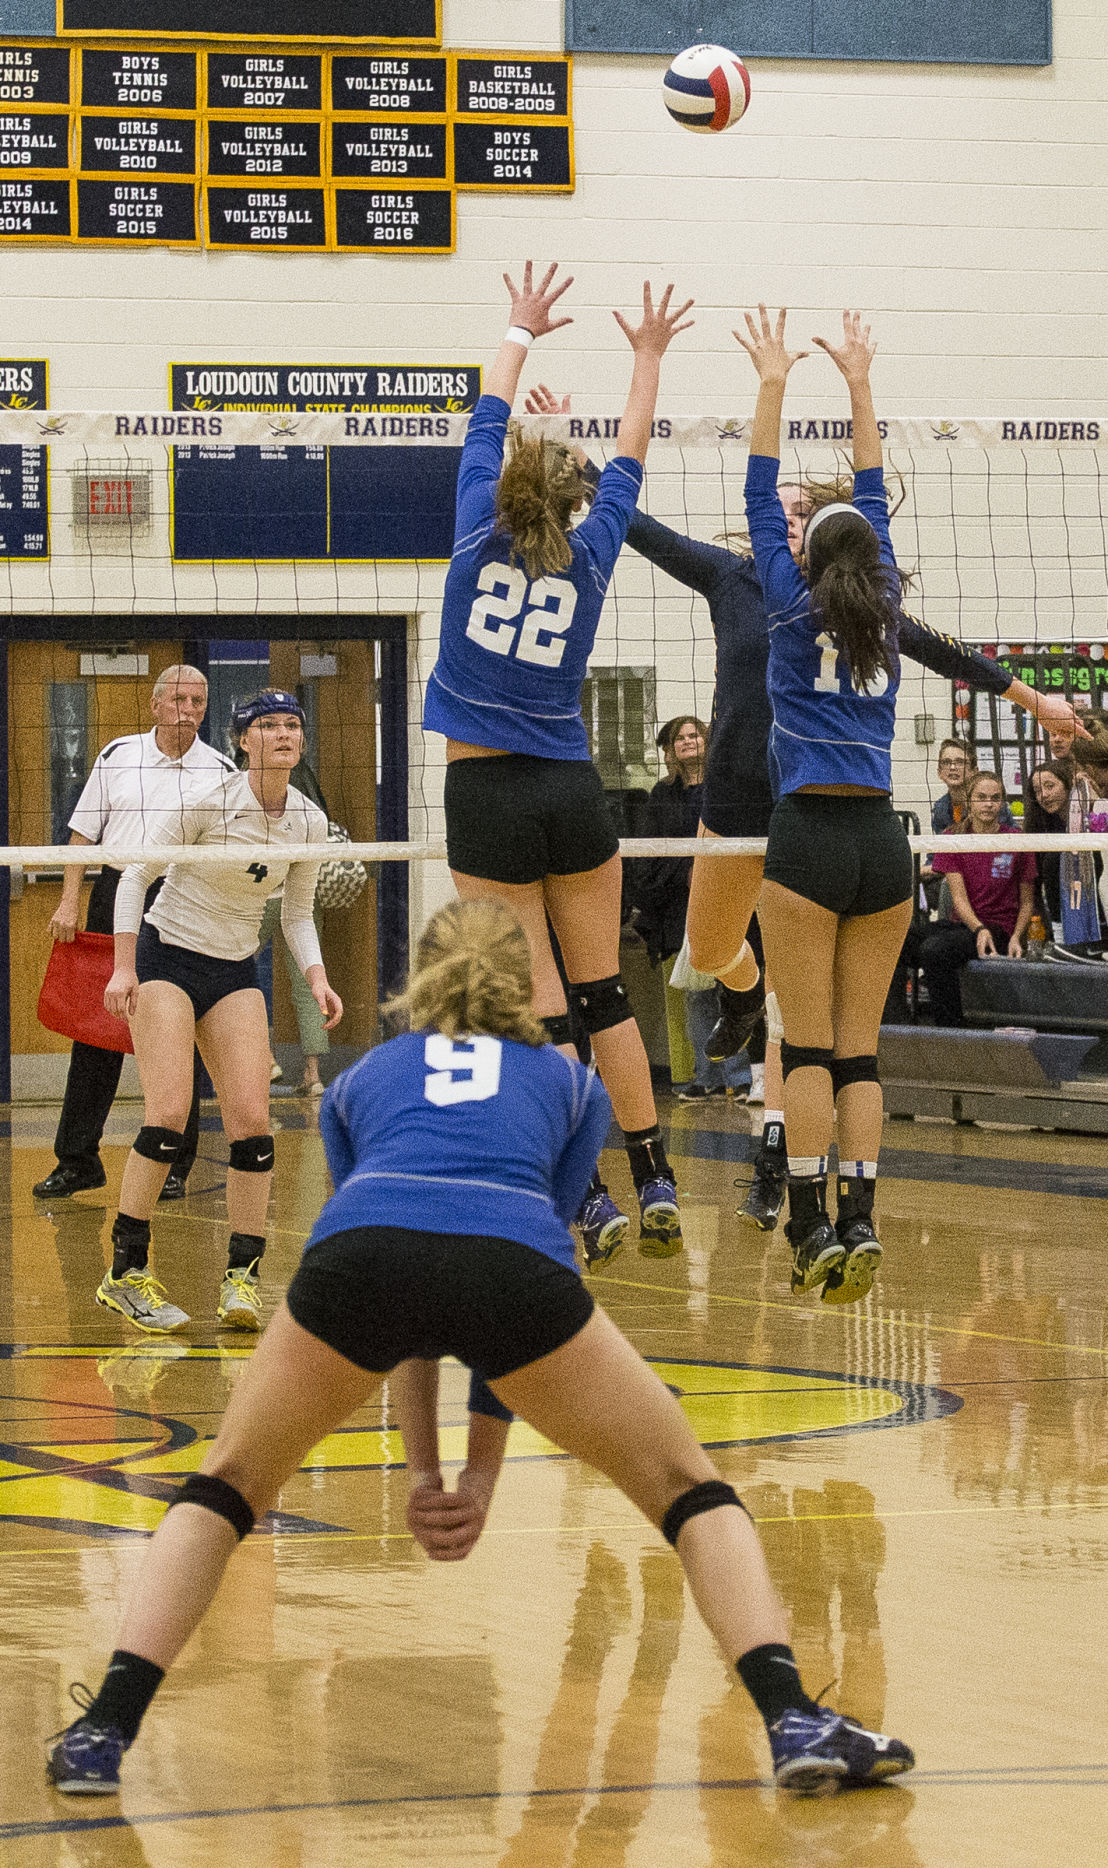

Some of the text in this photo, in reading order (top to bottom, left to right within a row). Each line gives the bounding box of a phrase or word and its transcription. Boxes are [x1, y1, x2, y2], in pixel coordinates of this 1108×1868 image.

[0, 51, 33, 66] IRLS
[121, 56, 160, 70] BOYS
[245, 58, 284, 73] GIRLS
[0, 68, 40, 83] NNIS
[370, 61, 409, 75] GIRLS
[493, 65, 532, 79] GIRLS
[112, 71, 168, 87] TENNIS
[221, 74, 309, 90] VOLLEYBALL
[345, 77, 434, 92] VOLLEYBALL
[0, 85, 34, 99] 003
[117, 88, 163, 103] 2006
[468, 80, 556, 96] BASKETBALL
[243, 91, 286, 106] 2007
[369, 94, 411, 108] 2008
[468, 96, 556, 112] 2008-2009
[0, 117, 31, 131] IRLS
[118, 121, 158, 135] GIRLS
[244, 126, 283, 140] GIRLS
[370, 127, 409, 141] GIRLS
[493, 131, 531, 145] BOYS
[0, 134, 57, 148] EYBALL
[94, 137, 183, 153] VOLLEYBALL
[221, 142, 307, 157] VOLLEYBALL
[345, 143, 434, 158] VOLLEYBALL
[486, 147, 539, 162] SOCCER
[0, 150, 32, 165] 009
[119, 154, 157, 169] 2010
[245, 158, 283, 172] 2012
[370, 159, 408, 173] 2013
[493, 164, 532, 178] 2014
[0, 184, 33, 198] IRLS
[114, 186, 158, 201] GIRLS
[0, 200, 58, 215] EYBALL
[247, 193, 287, 208] GIRLS
[371, 195, 414, 209] GIRLS
[108, 203, 164, 218] SOCCER
[223, 209, 313, 224] VOLLEYBALL
[366, 210, 420, 225] SOCCER
[116, 220, 157, 234] 2015
[250, 225, 288, 240] 2015
[373, 226, 414, 241] 2016
[185, 371, 469, 397] LOUDOUN COUNTY RAIDERS
[115, 416, 222, 436] RAIDERS
[345, 417, 449, 437] RAIDERS
[569, 418, 672, 438] RAIS
[788, 420, 888, 440] RAIDES
[1002, 421, 1100, 440] RAIDERS
[90, 481, 134, 514] EXIT
[465, 560, 578, 667] 22
[245, 862, 269, 883] 4
[424, 1033, 502, 1107] 9
